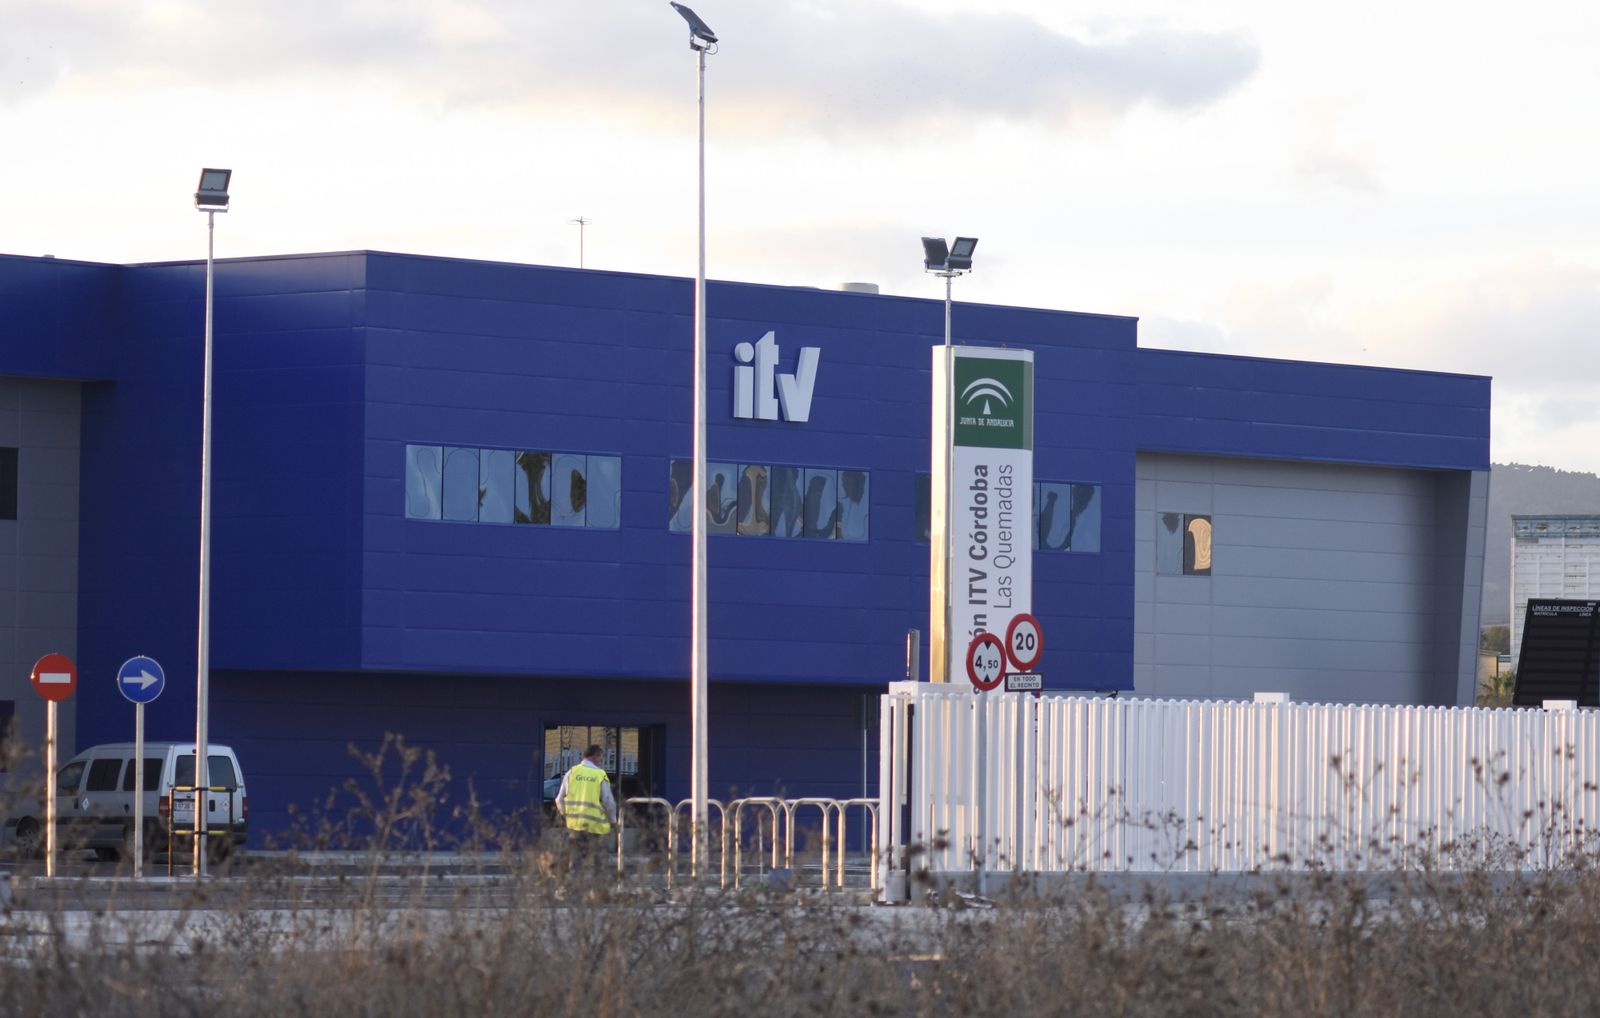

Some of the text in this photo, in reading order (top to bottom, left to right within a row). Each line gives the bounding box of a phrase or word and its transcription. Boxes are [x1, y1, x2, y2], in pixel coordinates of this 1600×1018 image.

[734, 331, 820, 422] itv
[960, 417, 976, 425] JUNTA
[978, 418, 985, 426] DE
[969, 465, 988, 561] Córdoba
[993, 465, 1016, 608] Las Quemadas
[969, 568, 987, 605] ITV
[1015, 633, 1035, 651] 20
[975, 655, 999, 671] 4,50
